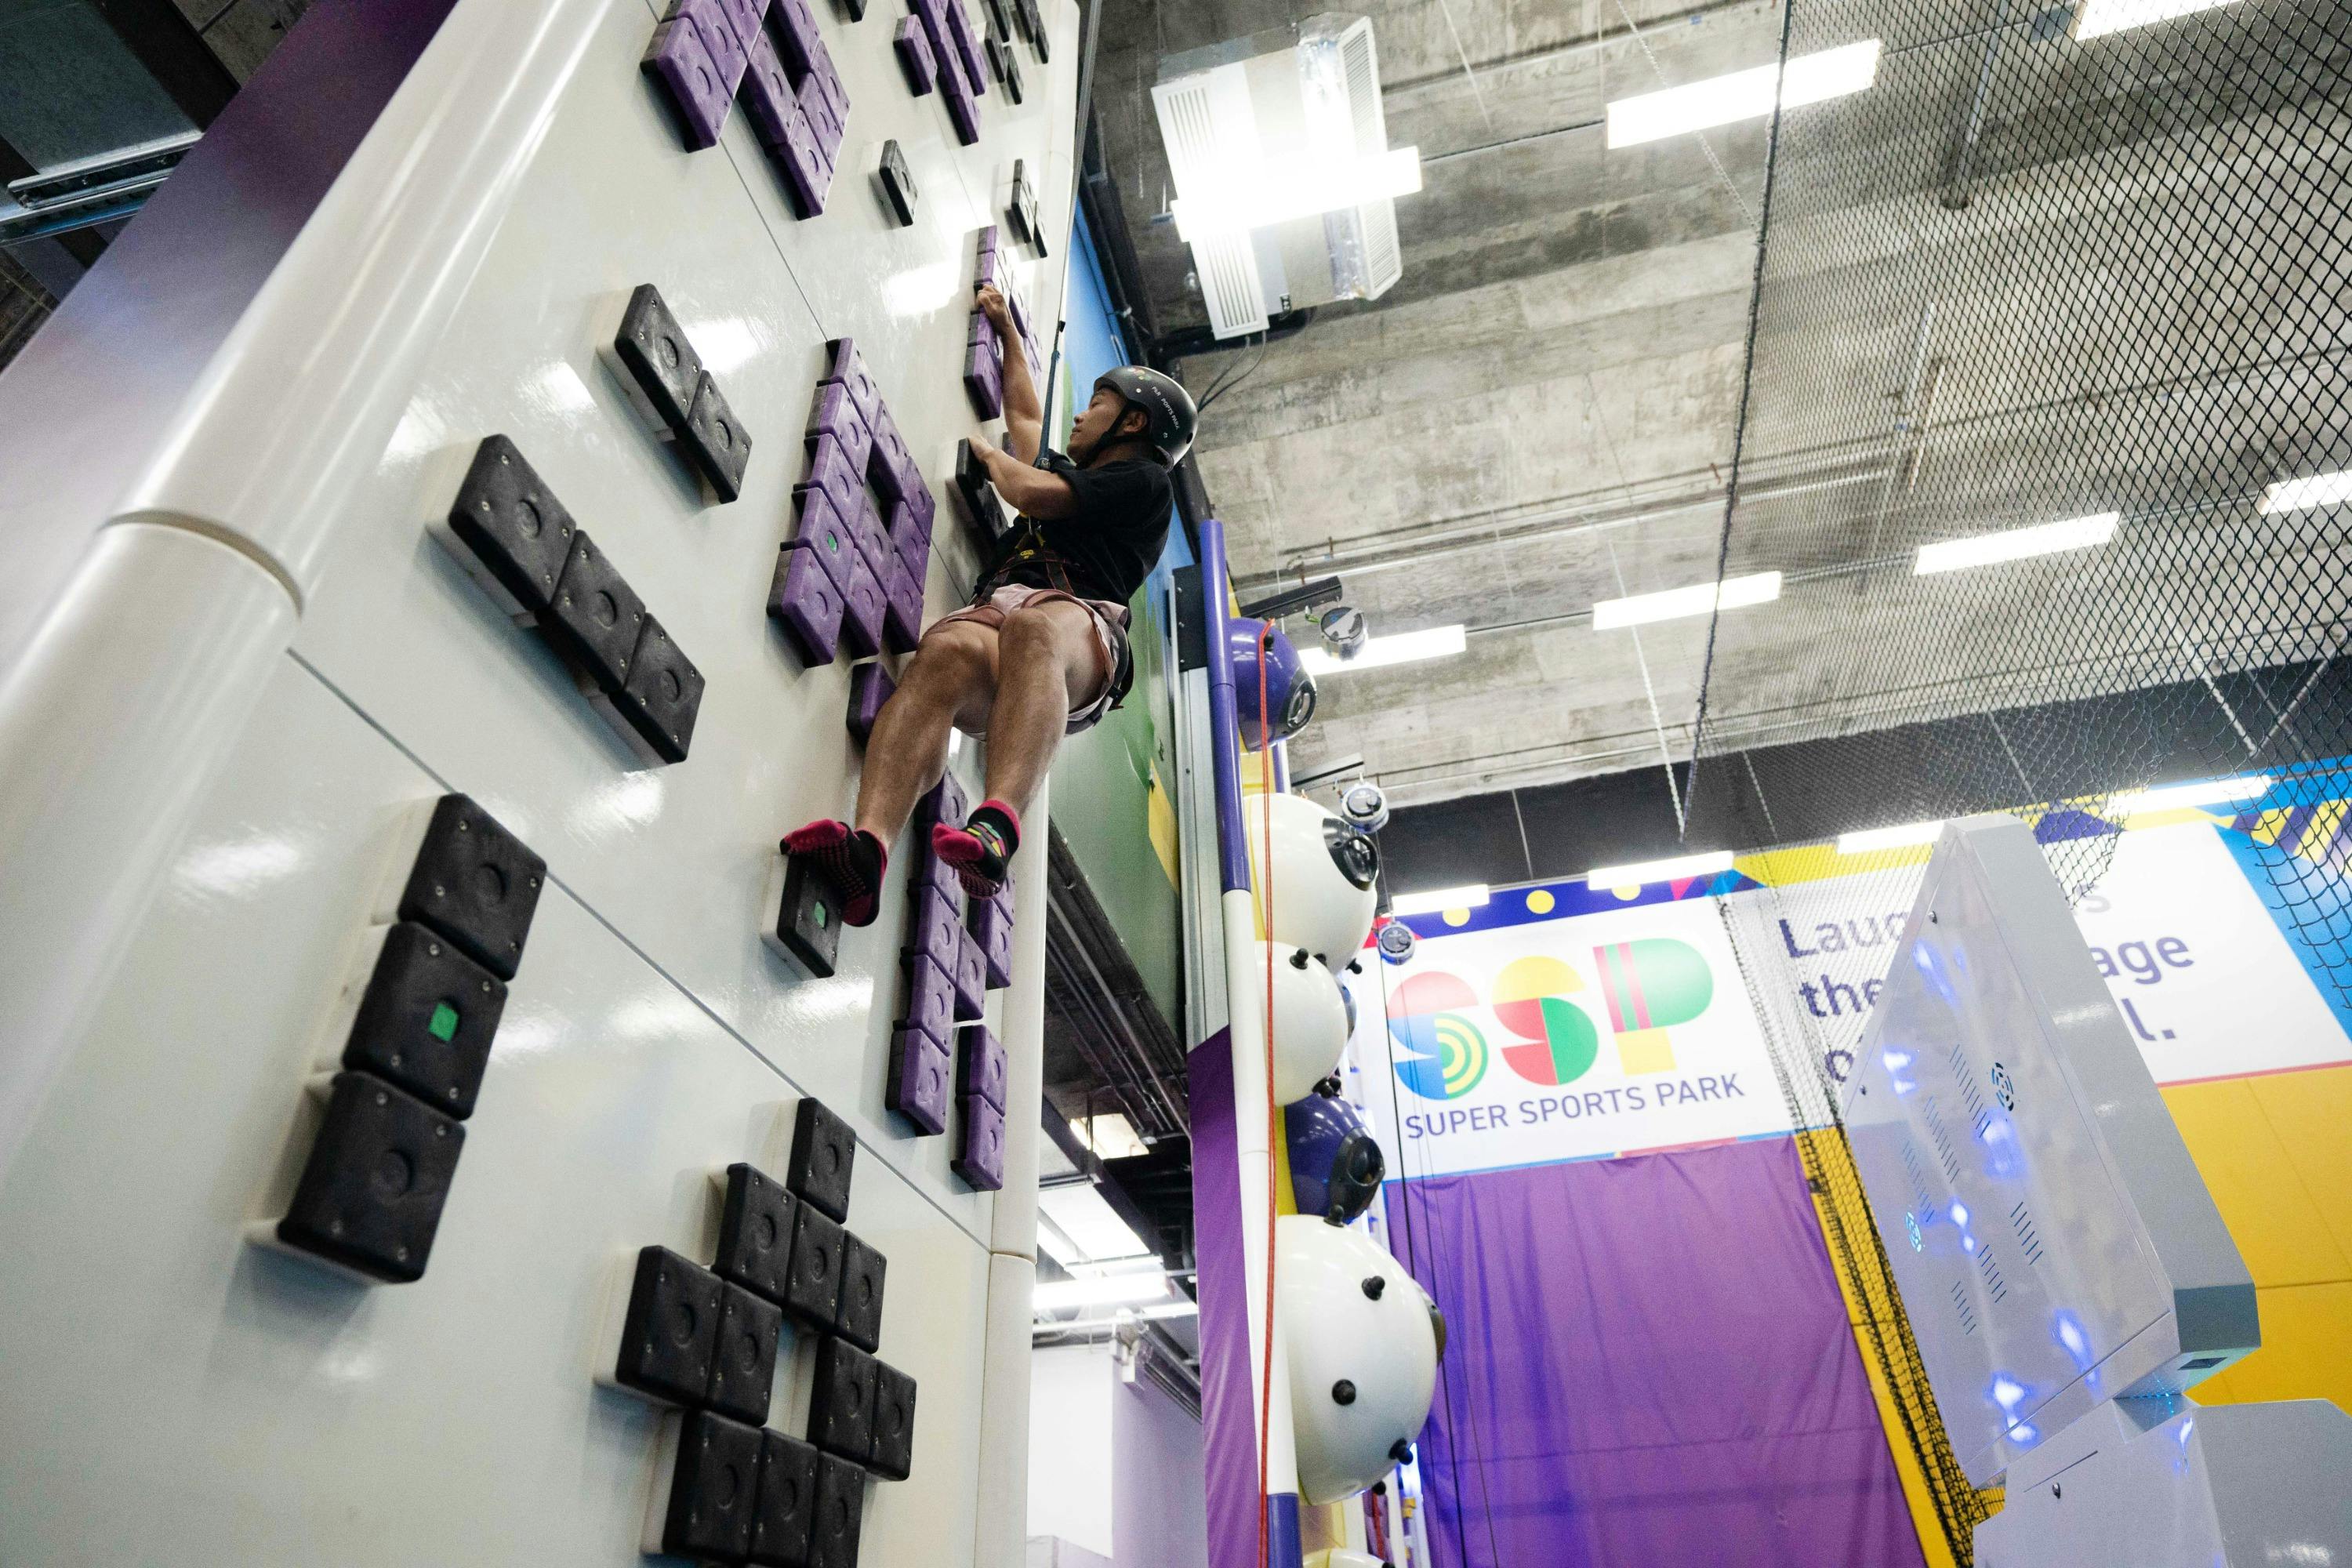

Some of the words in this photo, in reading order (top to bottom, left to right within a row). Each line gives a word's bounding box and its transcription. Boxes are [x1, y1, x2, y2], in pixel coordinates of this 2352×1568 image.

[2089, 936, 2194, 985] age
[1405, 1104, 1509, 1139] SUPER
[1519, 1085, 1646, 1126] SPORTS
[1655, 1073, 1745, 1107] PARK
